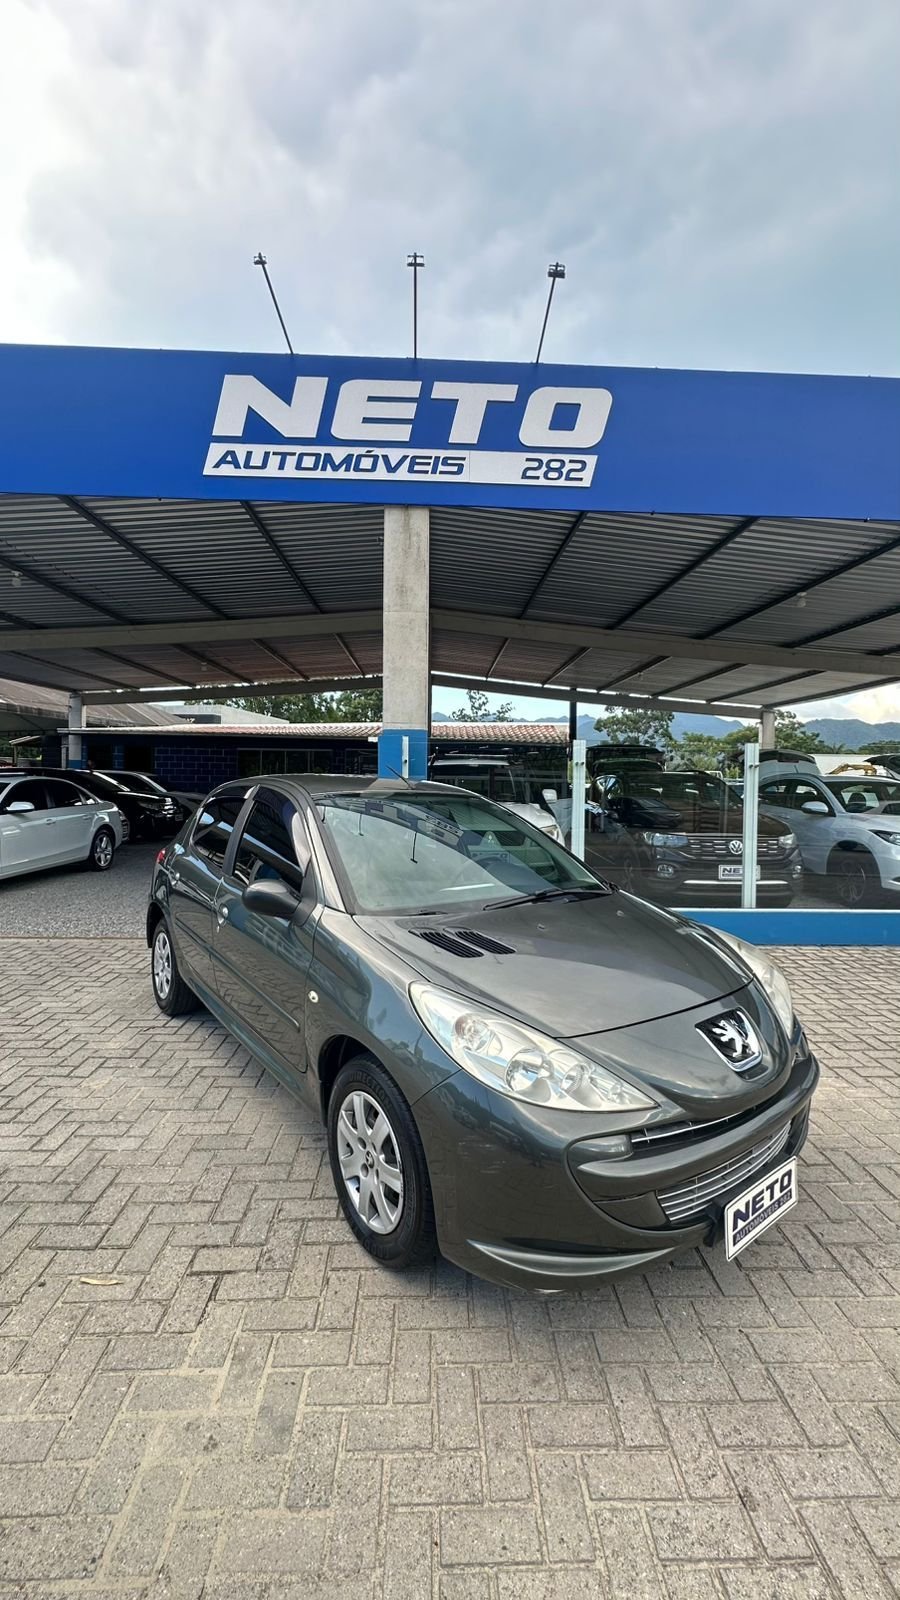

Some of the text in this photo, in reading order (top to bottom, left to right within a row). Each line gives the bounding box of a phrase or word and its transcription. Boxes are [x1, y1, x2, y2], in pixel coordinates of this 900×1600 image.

[212, 374, 613, 448] NETO
[212, 449, 588, 482] AUTOMÓVEIS 282
[732, 1169, 792, 1232] NETO
